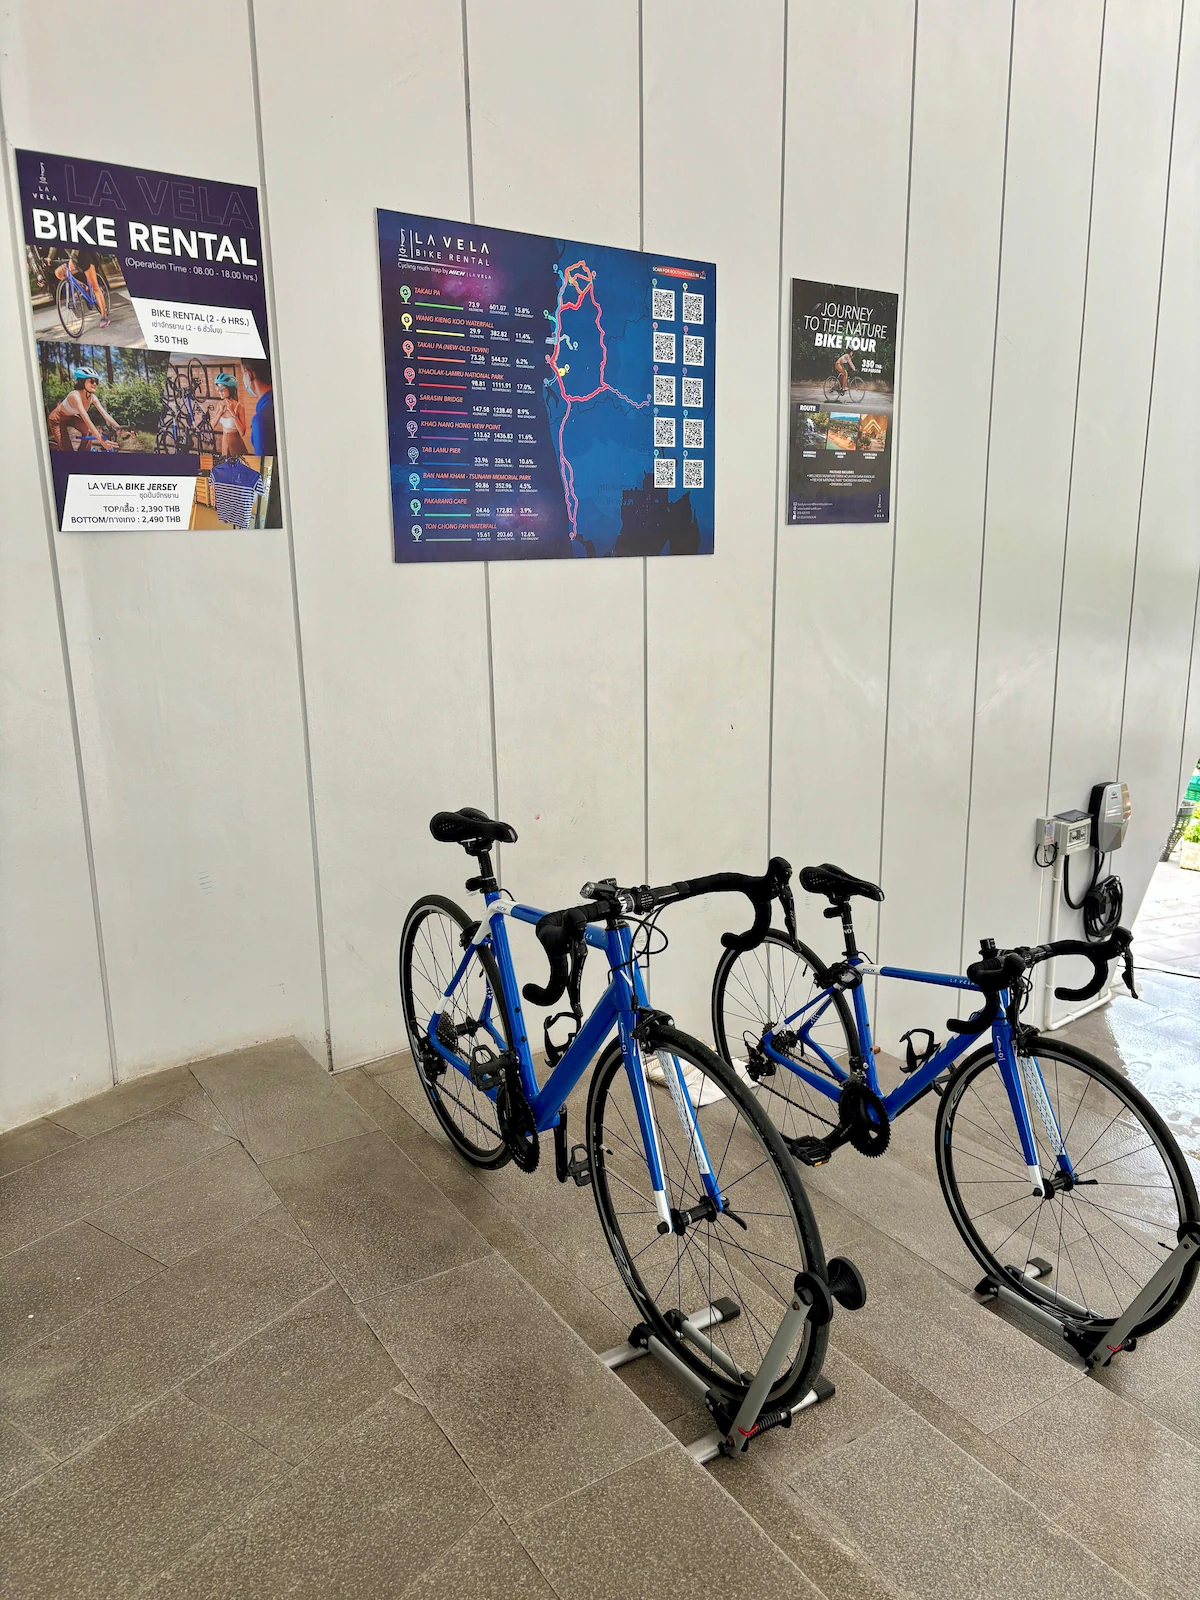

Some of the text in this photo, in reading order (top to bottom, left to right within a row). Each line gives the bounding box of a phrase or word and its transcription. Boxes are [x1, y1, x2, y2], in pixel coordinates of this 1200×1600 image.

[32, 192, 58, 202] VELA
[65, 164, 254, 230] LA VELA
[32, 208, 258, 266] BIKE RENTAL
[415, 232, 489, 254] LA VELA
[398, 262, 416, 271] Cycling
[416, 249, 489, 266] BIKE RENTAL
[125, 257, 166, 271] (Operation
[168, 262, 187, 273] Time
[193, 266, 214, 276] 08.00
[221, 270, 241, 279] 18.00
[243, 272, 258, 282] hrs.)
[151, 308, 170, 318] BIKE
[173, 311, 204, 321] RENTAL
[206, 315, 214, 323] (2
[228, 317, 249, 326] HRS.)
[821, 302, 873, 321] JOURNEY
[465, 320, 494, 328] WATERFALL
[804, 315, 887, 339] TO THE NATURE
[154, 335, 188, 345] 350 THB
[815, 333, 876, 352] BIKE TOUR
[862, 359, 874, 368] 350
[88, 482, 99, 490] LA
[147, 483, 178, 491] JERSEY
